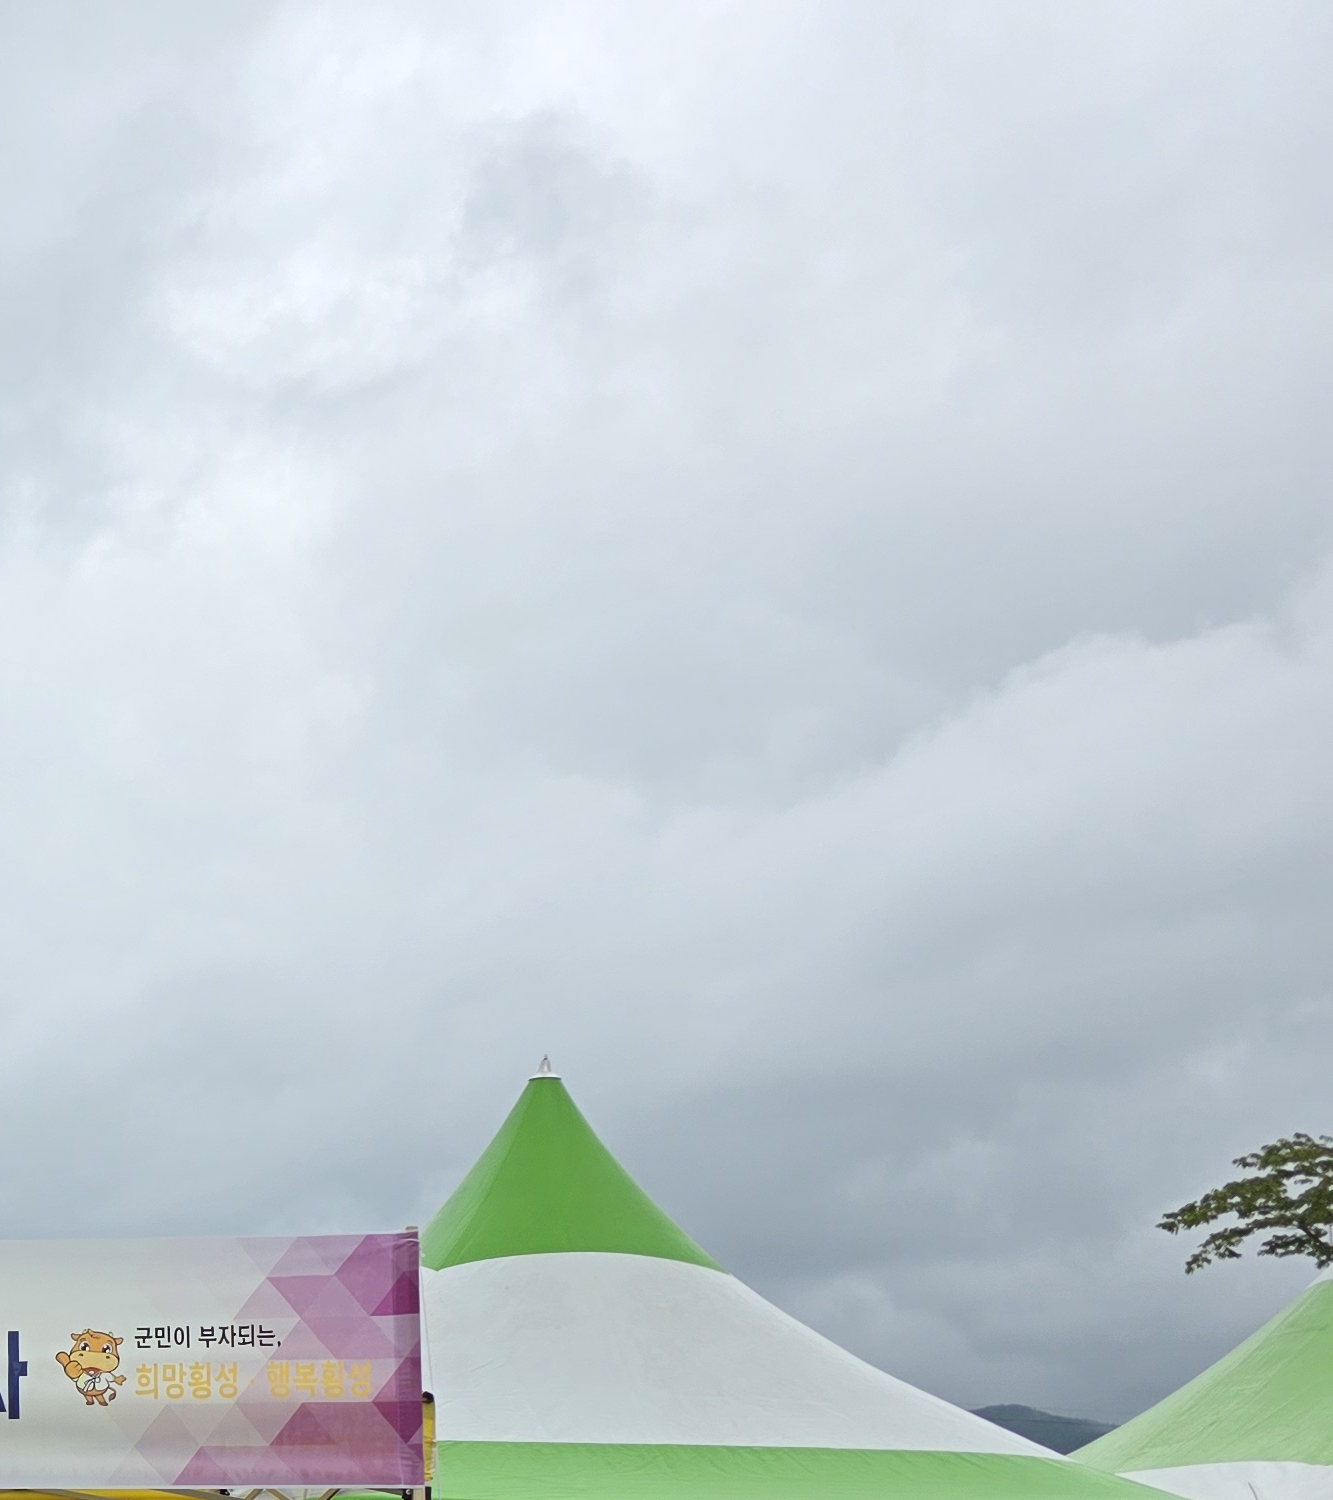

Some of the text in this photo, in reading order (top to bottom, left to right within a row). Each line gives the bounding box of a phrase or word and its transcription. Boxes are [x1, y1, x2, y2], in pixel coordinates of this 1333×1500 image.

[134, 1322, 282, 1350] 군민이 부자되는,
[134, 1359, 373, 1400] 희망횡성 행복횡성
